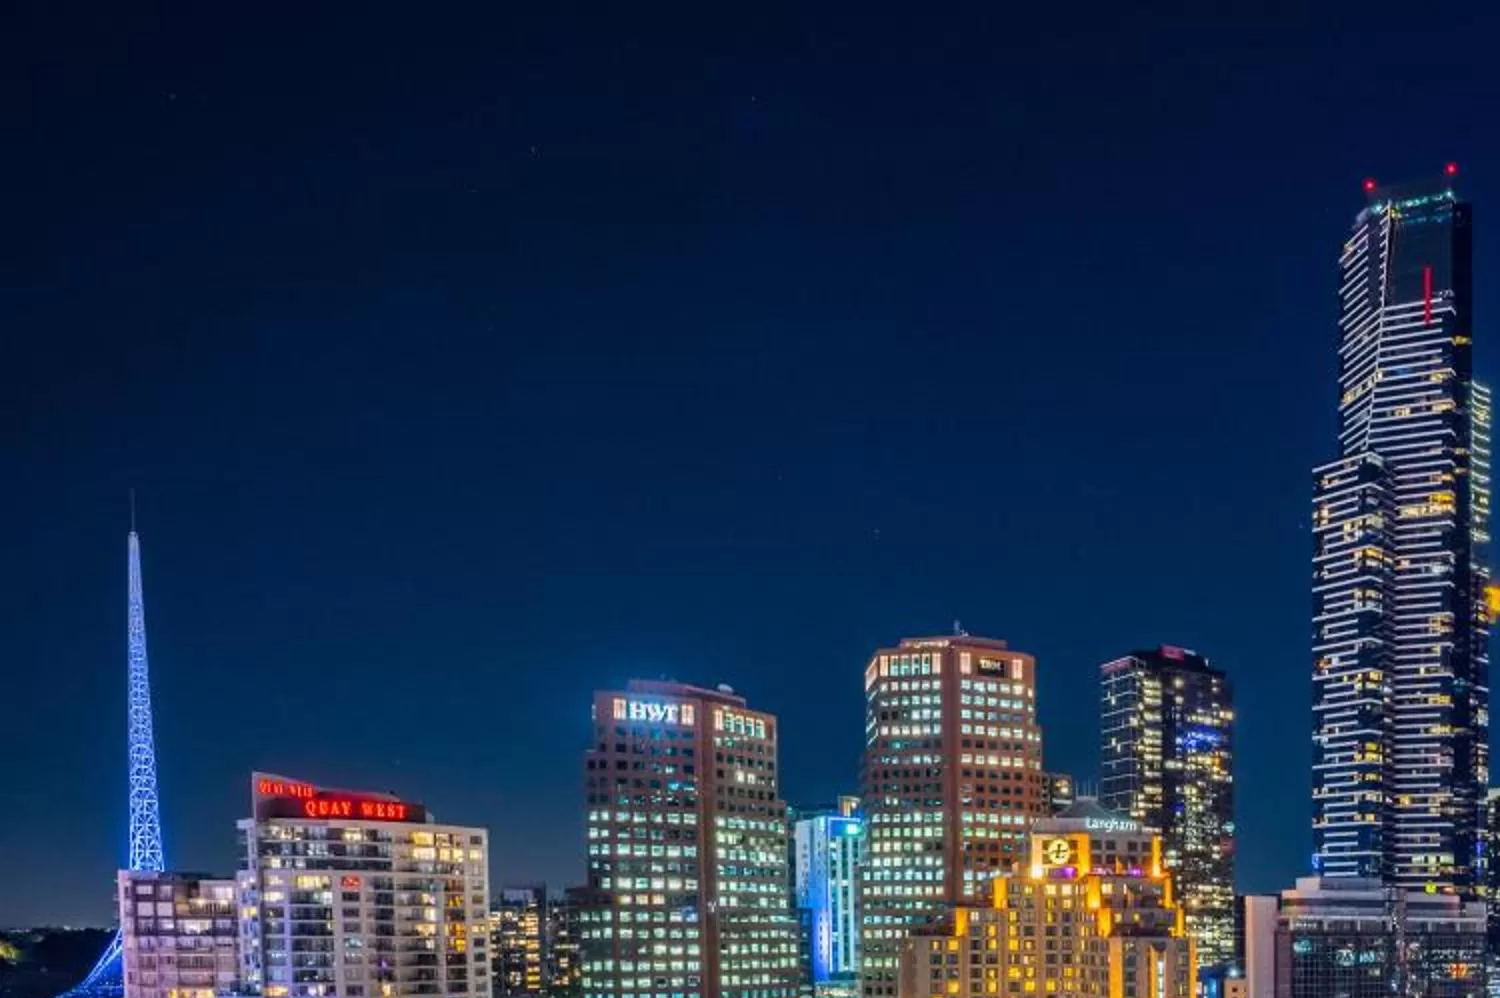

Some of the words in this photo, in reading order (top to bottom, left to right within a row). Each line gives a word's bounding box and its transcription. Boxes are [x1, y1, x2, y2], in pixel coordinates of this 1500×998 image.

[630, 701, 678, 724] HWT
[305, 800, 351, 817] QUAY
[361, 803, 406, 819] WEST
[1085, 817, 1138, 833] Langham
